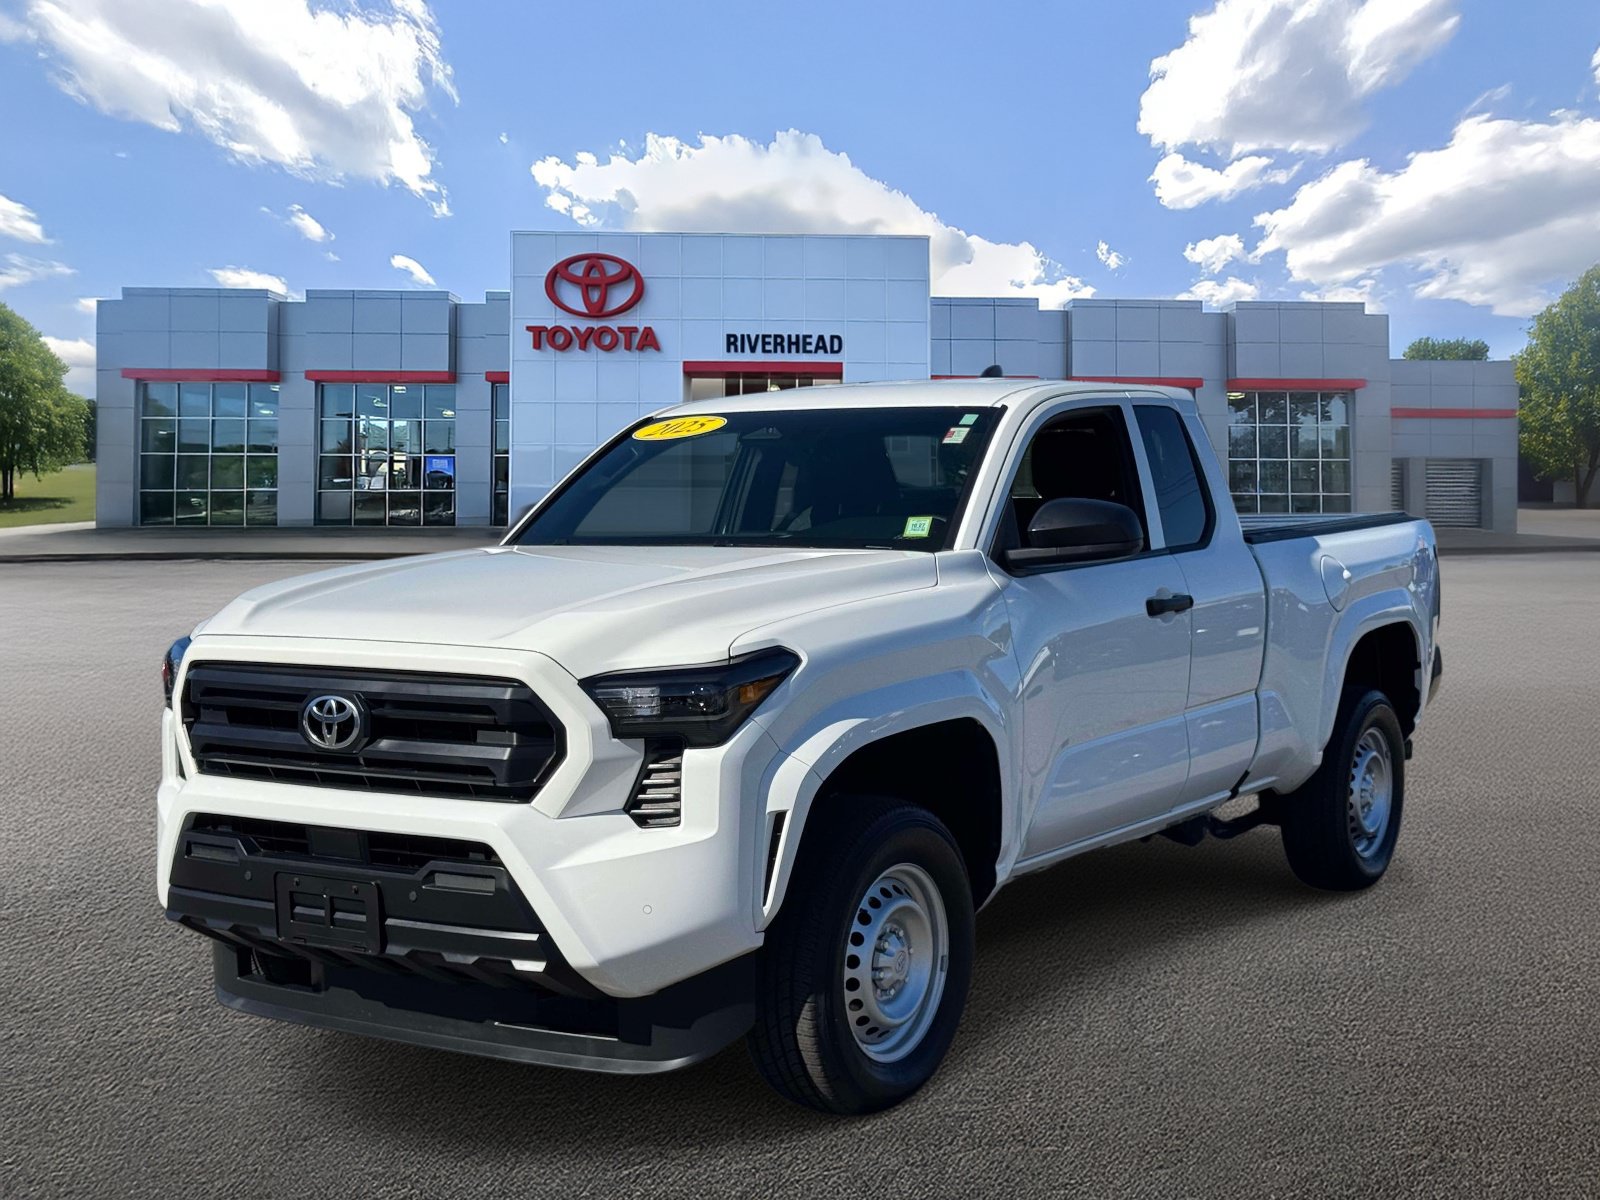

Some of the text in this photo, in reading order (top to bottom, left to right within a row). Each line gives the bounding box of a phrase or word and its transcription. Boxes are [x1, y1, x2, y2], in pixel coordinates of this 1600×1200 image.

[526, 325, 660, 351] TOYOTA
[726, 333, 843, 354] RIVERHEAD
[643, 418, 717, 437] 2025
